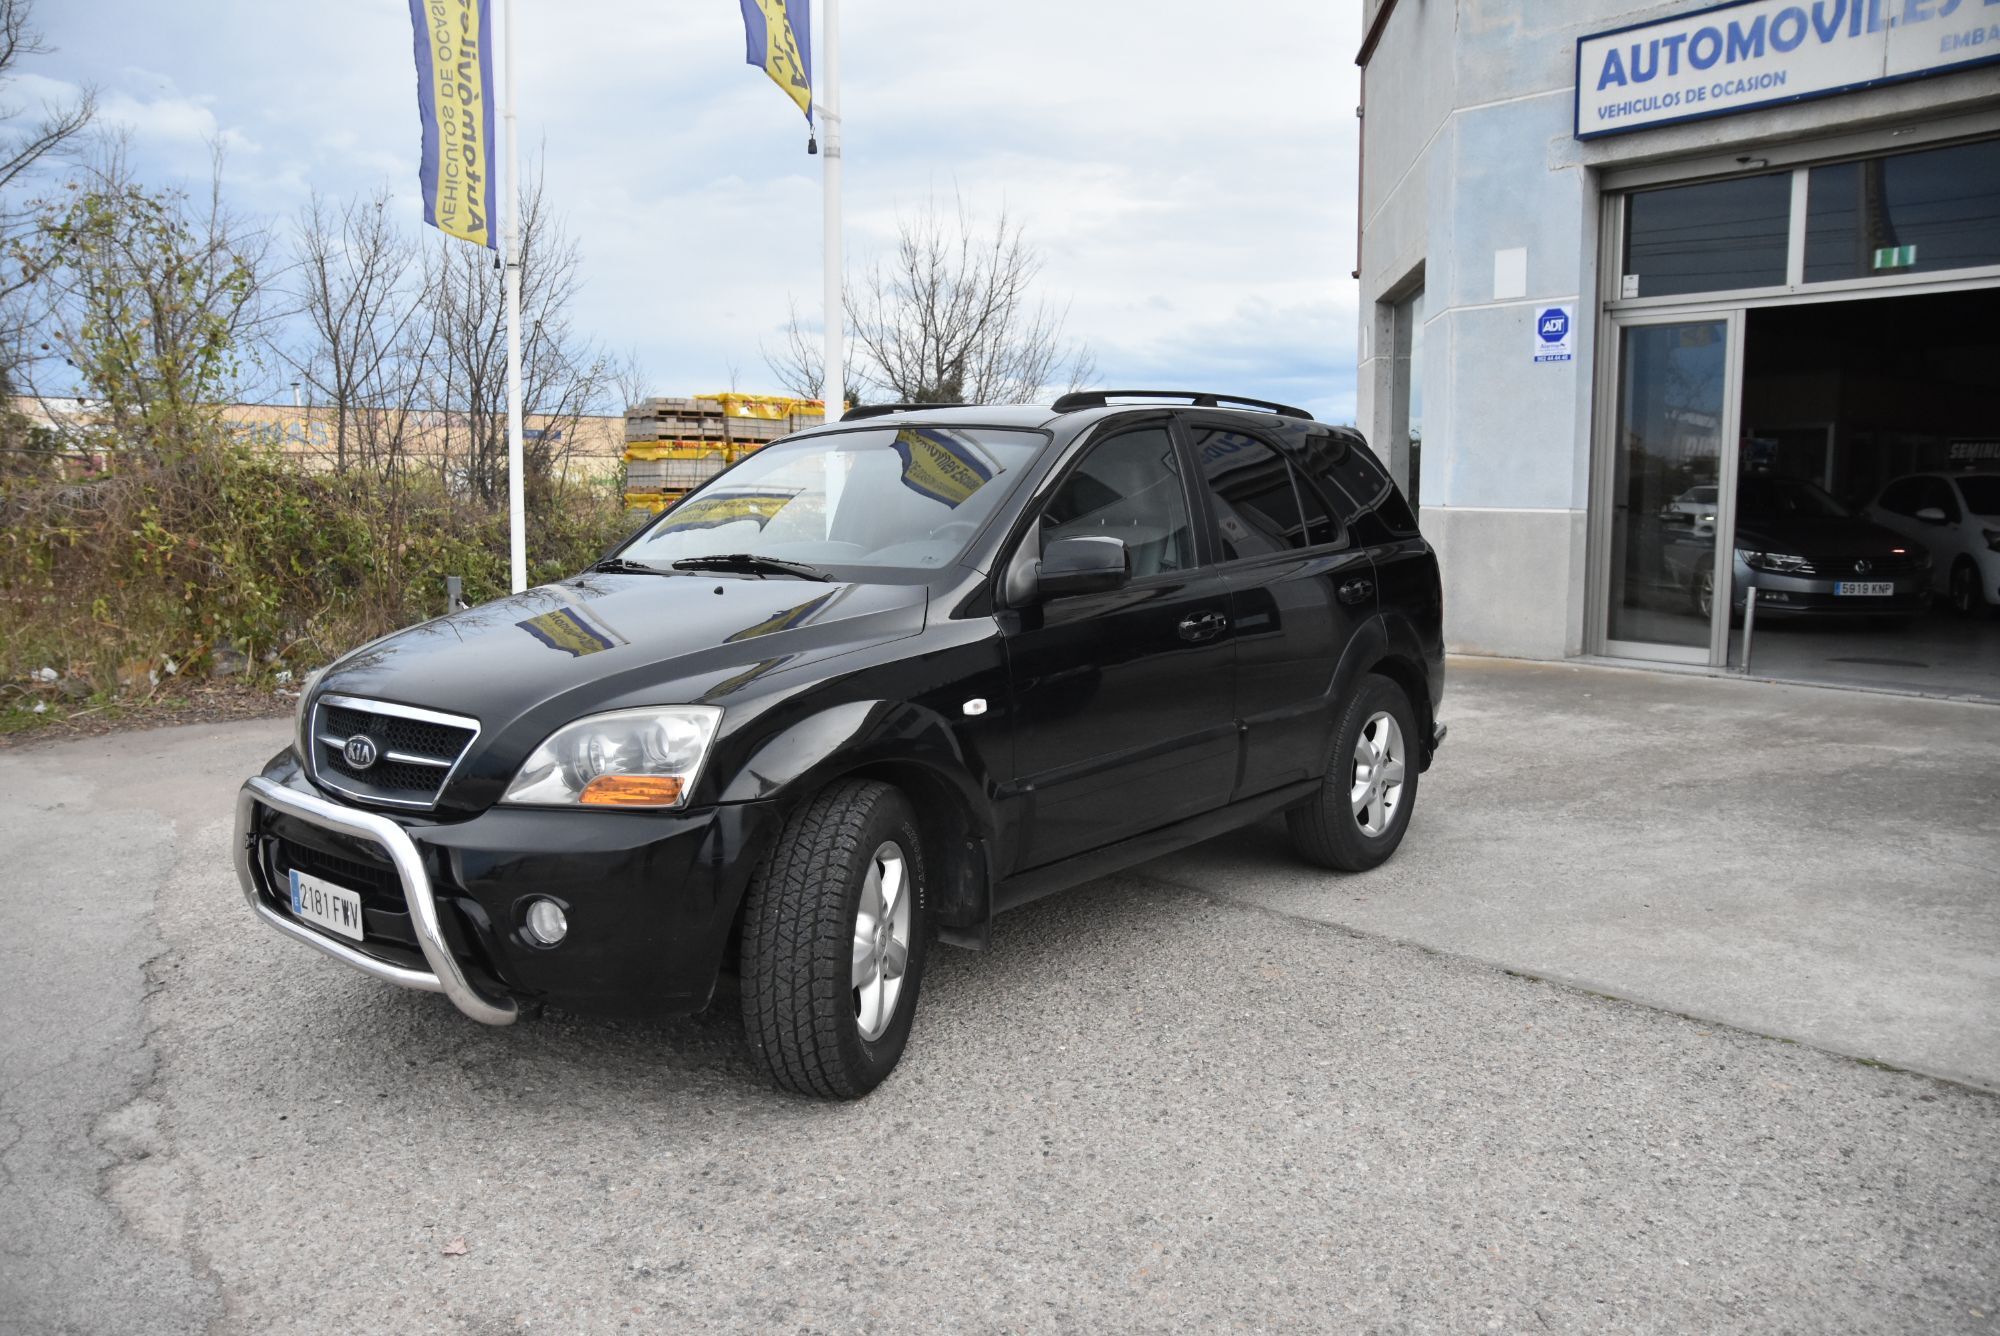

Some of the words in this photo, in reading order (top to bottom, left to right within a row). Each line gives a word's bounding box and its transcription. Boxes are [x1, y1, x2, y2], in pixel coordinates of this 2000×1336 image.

[1598, 91, 1681, 119] VEHICULOS
[1685, 86, 1706, 104] DE
[1711, 70, 1786, 97] OCASION
[1543, 318, 1564, 332] ADT
[1842, 583, 1869, 594] 5919
[1872, 583, 1892, 594] KNP
[348, 742, 370, 763] KIA
[300, 883, 329, 919] 2181
[332, 896, 358, 930] FWV
